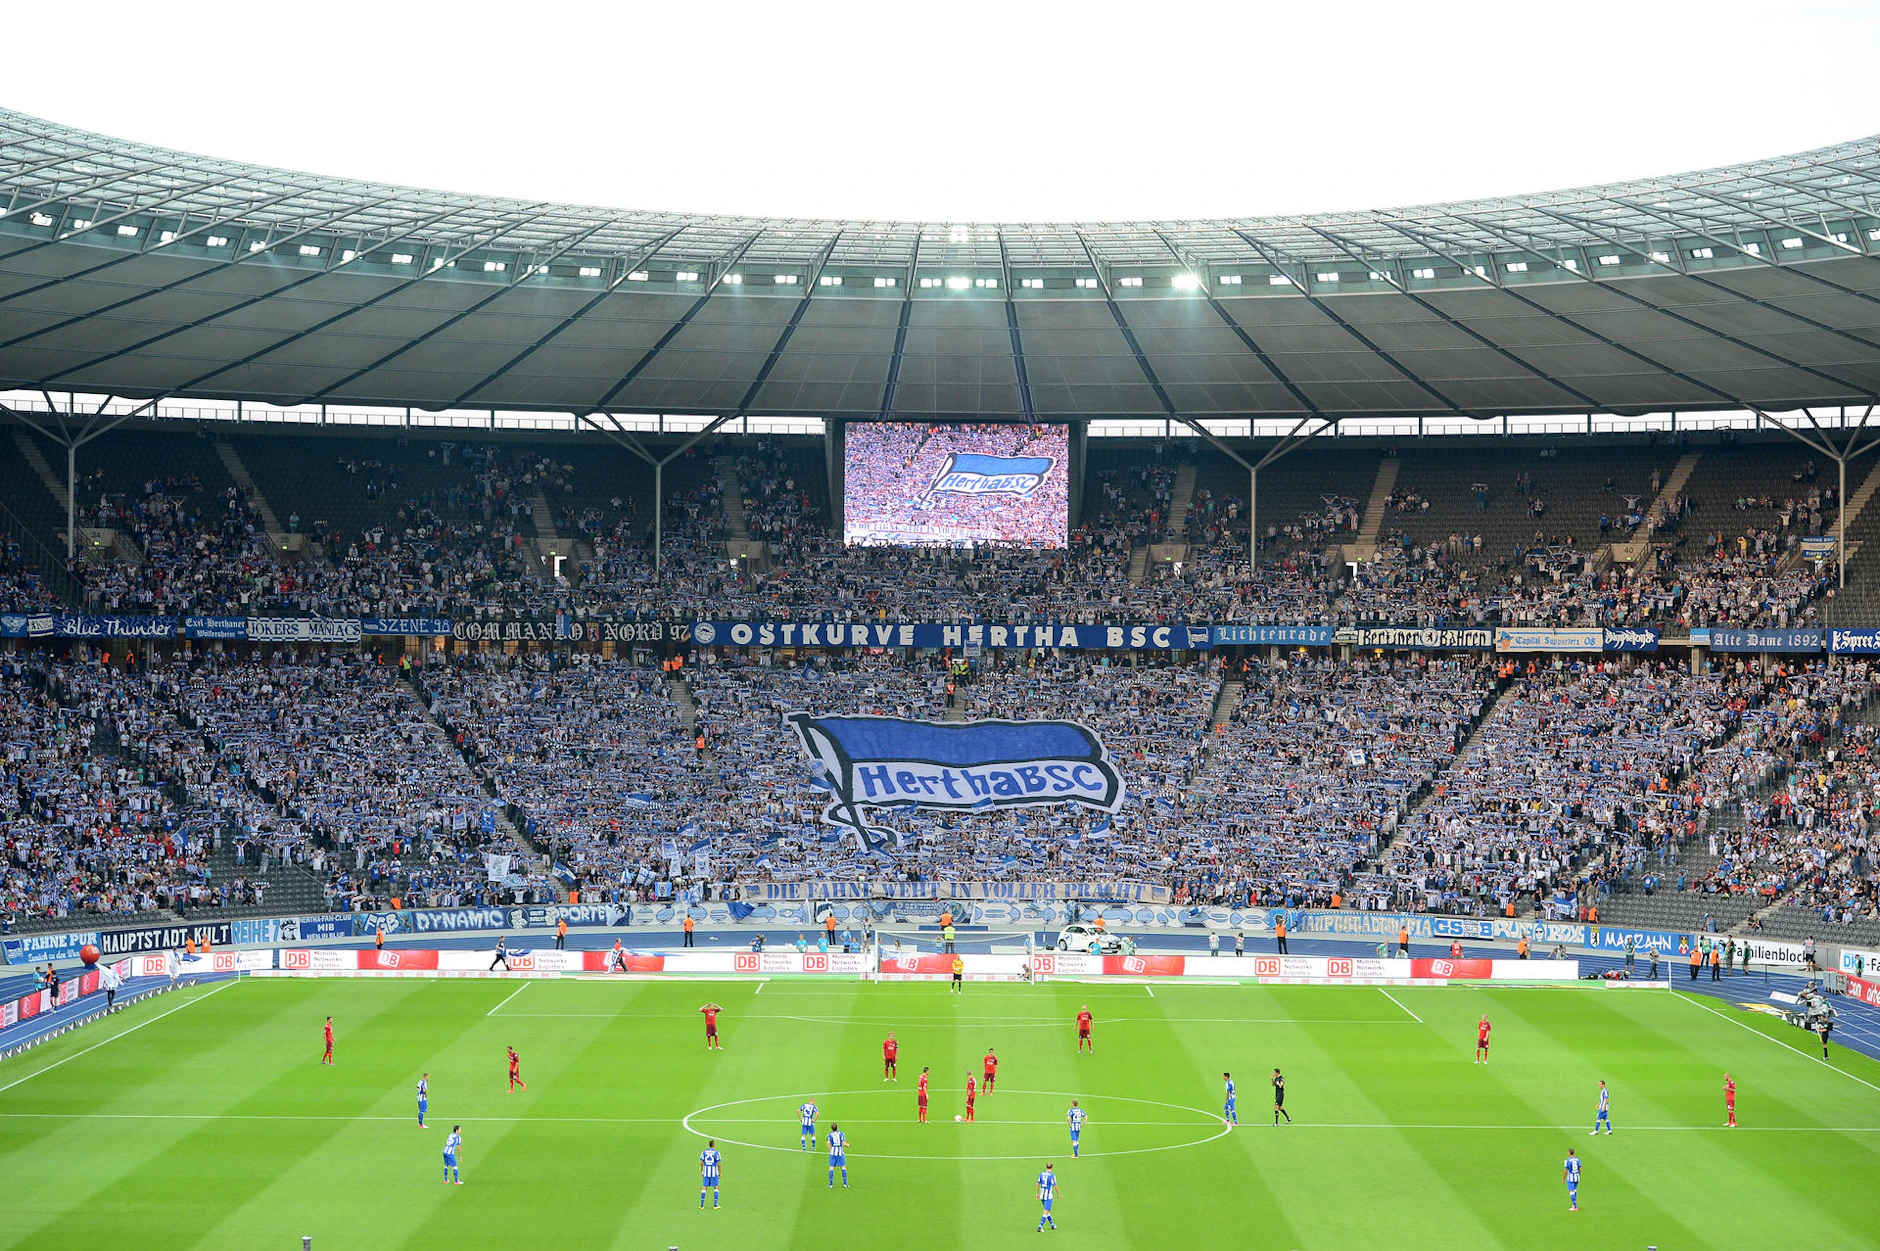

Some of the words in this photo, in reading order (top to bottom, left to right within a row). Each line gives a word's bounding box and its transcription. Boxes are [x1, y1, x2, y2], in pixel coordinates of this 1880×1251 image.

[63, 614, 100, 636] Blue
[104, 618, 171, 636] Thunder
[250, 624, 299, 636] JOKERS
[309, 624, 361, 637] MANIACS
[379, 619, 429, 633] SZENE
[730, 623, 915, 646] OSTKURVE
[942, 625, 1079, 647] HERTHA
[1106, 626, 1171, 648] BSC
[1217, 627, 1327, 642] Lichtenrade
[1514, 636, 1541, 645] Capital
[1544, 636, 1580, 646] Supporters
[1583, 637, 1596, 646] 08
[1713, 632, 1741, 646] Alte
[1747, 633, 1782, 647] Dame
[1788, 633, 1819, 647] 1892
[767, 883, 800, 899] DIE
[807, 883, 870, 899] FAHNE
[883, 883, 940, 898] WEHT
[951, 883, 972, 898] IN
[982, 883, 1055, 899] VOLLER
[1064, 883, 1146, 899] PRACHT
[415, 907, 504, 932] DYNAMIC
[232, 919, 269, 945] REIHE
[271, 919, 280, 942] 7
[317, 923, 335, 932] MIB
[1494, 919, 1533, 940] RUDE
[1547, 922, 1585, 943] BOYS
[23, 935, 68, 951] FAHNE
[69, 932, 97, 946] PUR
[103, 930, 186, 952] HAUPTSTADT
[146, 959, 163, 971] DB
[216, 956, 233, 968] DB
[288, 953, 307, 966] DB
[382, 953, 398, 966] DB
[738, 956, 757, 968] DB
[805, 956, 825, 969] DB
[1034, 958, 1052, 971] DB
[1128, 958, 1143, 971] DB
[1258, 961, 1277, 972] DB
[1331, 962, 1350, 974] DB
[1435, 962, 1451, 974] DB
